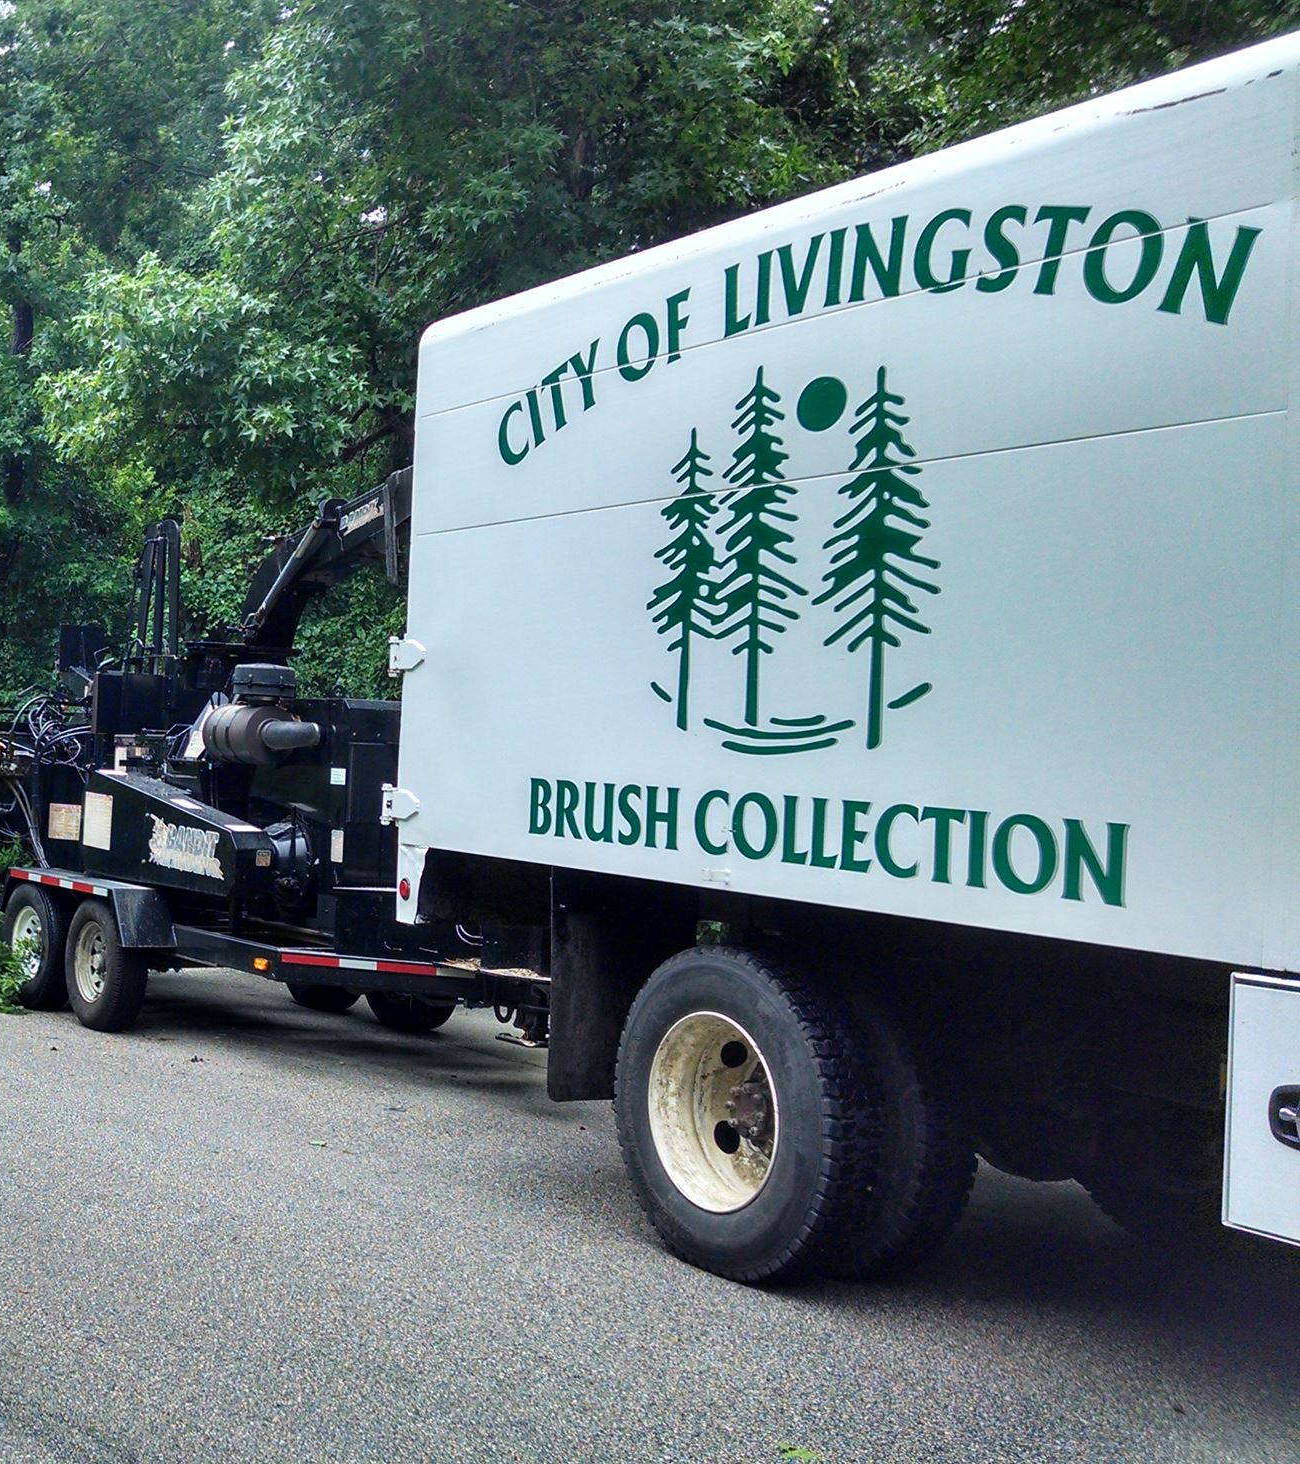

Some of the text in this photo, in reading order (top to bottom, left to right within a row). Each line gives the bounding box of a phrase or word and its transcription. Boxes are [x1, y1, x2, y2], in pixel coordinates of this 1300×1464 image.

[497, 203, 1263, 466] CITY OF LIVINGSTON
[528, 777, 680, 852] BRUSH
[694, 789, 1130, 908] COLLECTION
